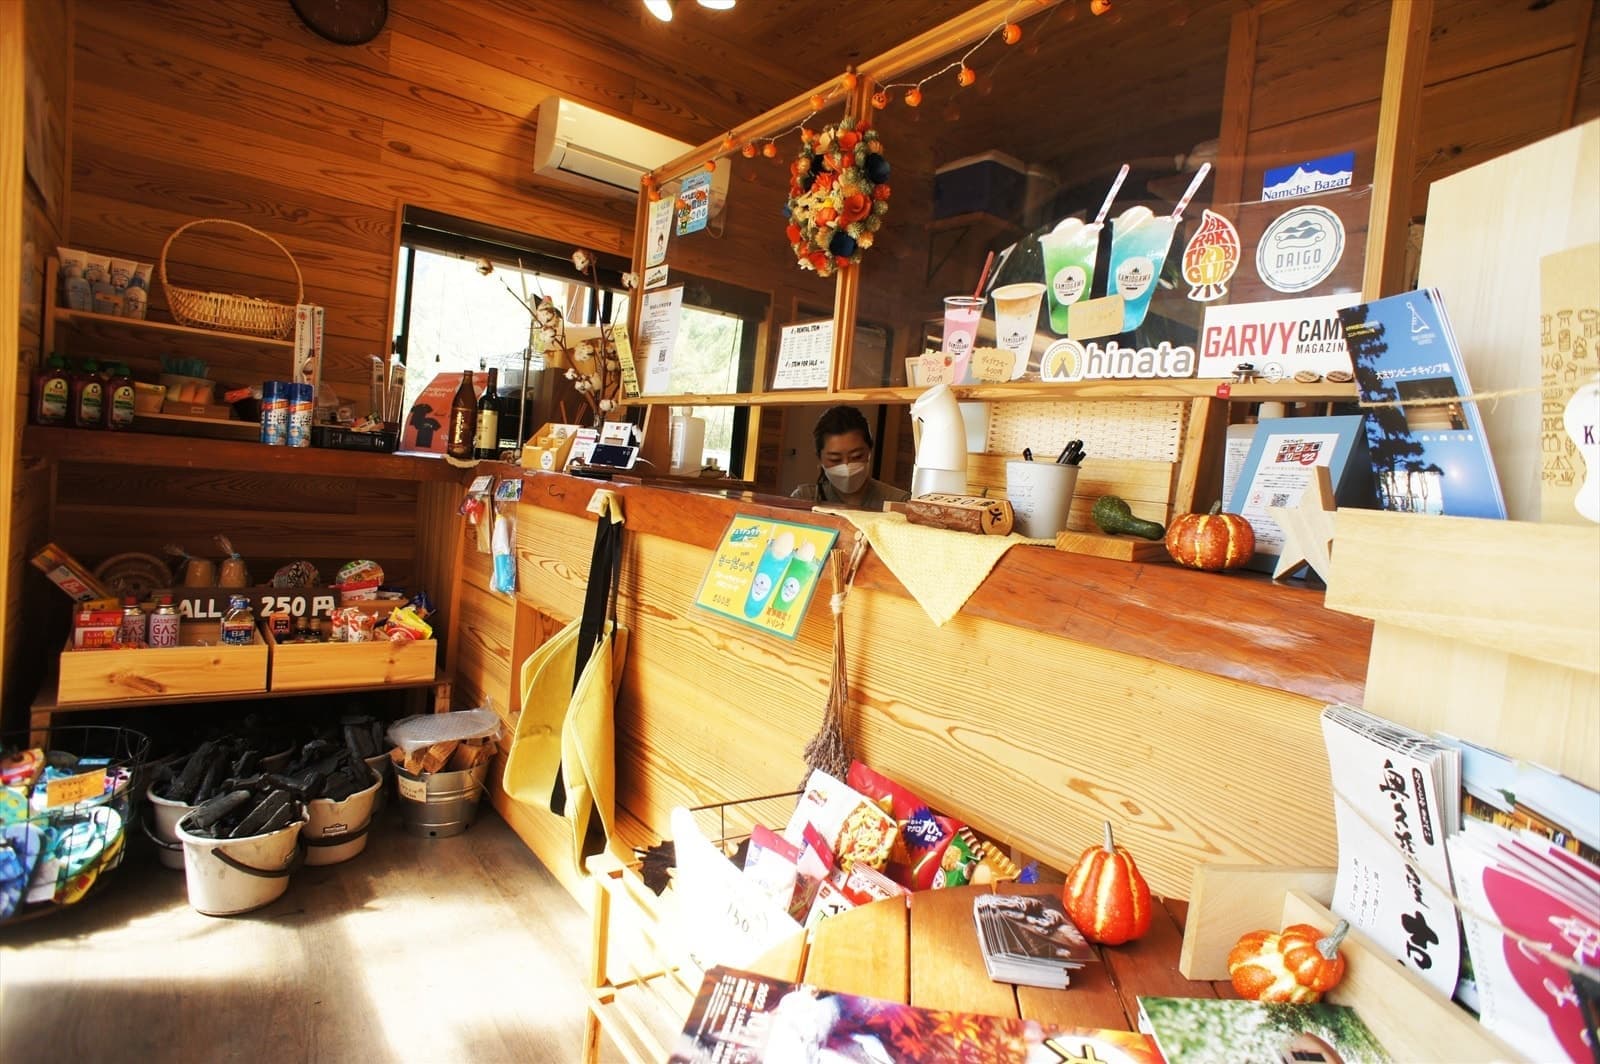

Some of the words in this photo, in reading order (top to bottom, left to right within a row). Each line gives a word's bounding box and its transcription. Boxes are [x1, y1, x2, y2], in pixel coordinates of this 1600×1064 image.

[1263, 184, 1310, 200] Namche
[1314, 176, 1350, 191] Bazar
[1276, 249, 1321, 269] DAIGO
[1204, 321, 1297, 358] GARVY
[1296, 342, 1348, 354] MAGAZIN
[1087, 343, 1192, 375] hinata
[179, 598, 222, 619] ALL
[260, 596, 306, 617] 250
[312, 595, 335, 617] 円
[153, 624, 177, 635] GAS
[153, 635, 177, 646] SUN
